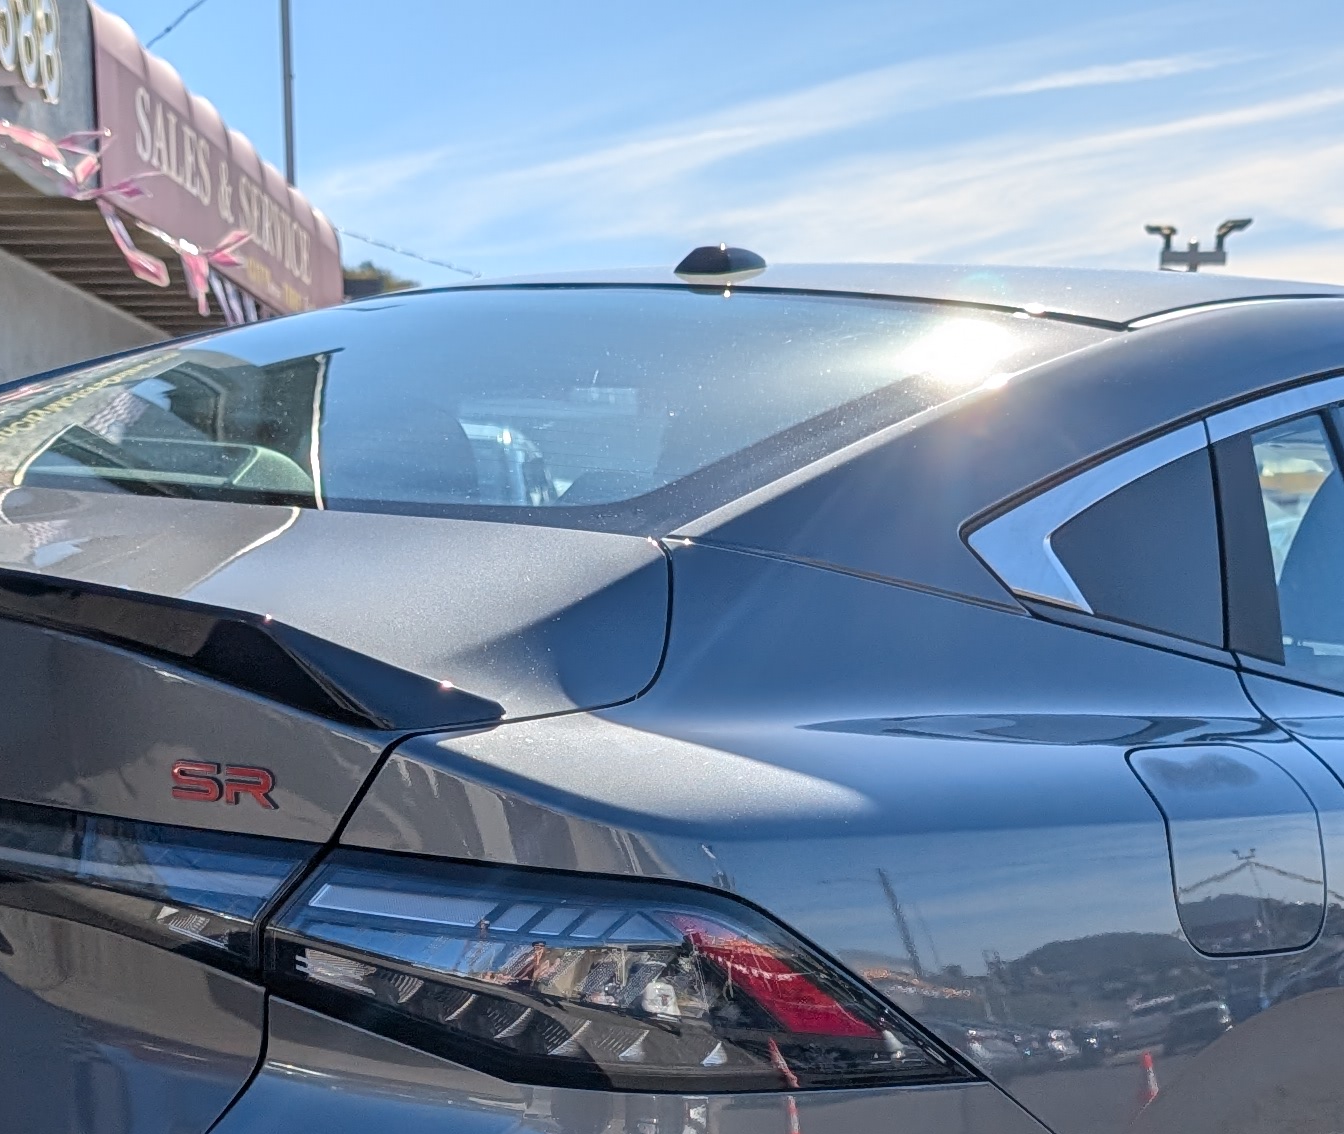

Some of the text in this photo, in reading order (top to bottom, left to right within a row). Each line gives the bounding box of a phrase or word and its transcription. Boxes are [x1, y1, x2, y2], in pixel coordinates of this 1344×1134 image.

[134, 86, 212, 206] SALES
[218, 161, 235, 225] &
[238, 175, 313, 286] SERVICE
[171, 760, 279, 810] SR
